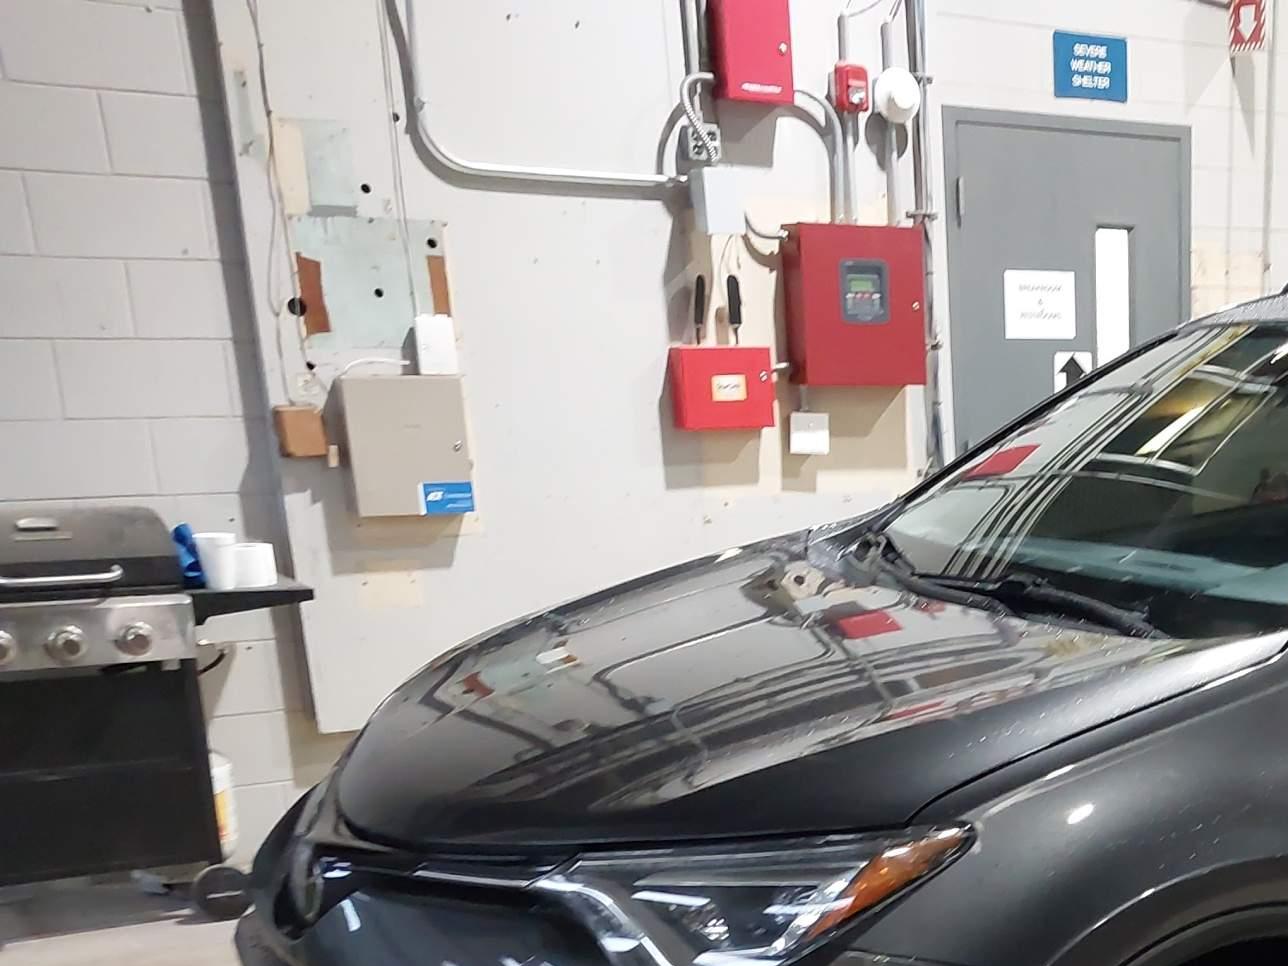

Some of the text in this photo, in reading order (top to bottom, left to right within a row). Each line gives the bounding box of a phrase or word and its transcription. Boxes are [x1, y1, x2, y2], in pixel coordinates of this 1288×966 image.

[1073, 43, 1107, 59] SEVERE
[1070, 58, 1112, 75] WEATHER
[1071, 74, 1110, 89] SHELTER
